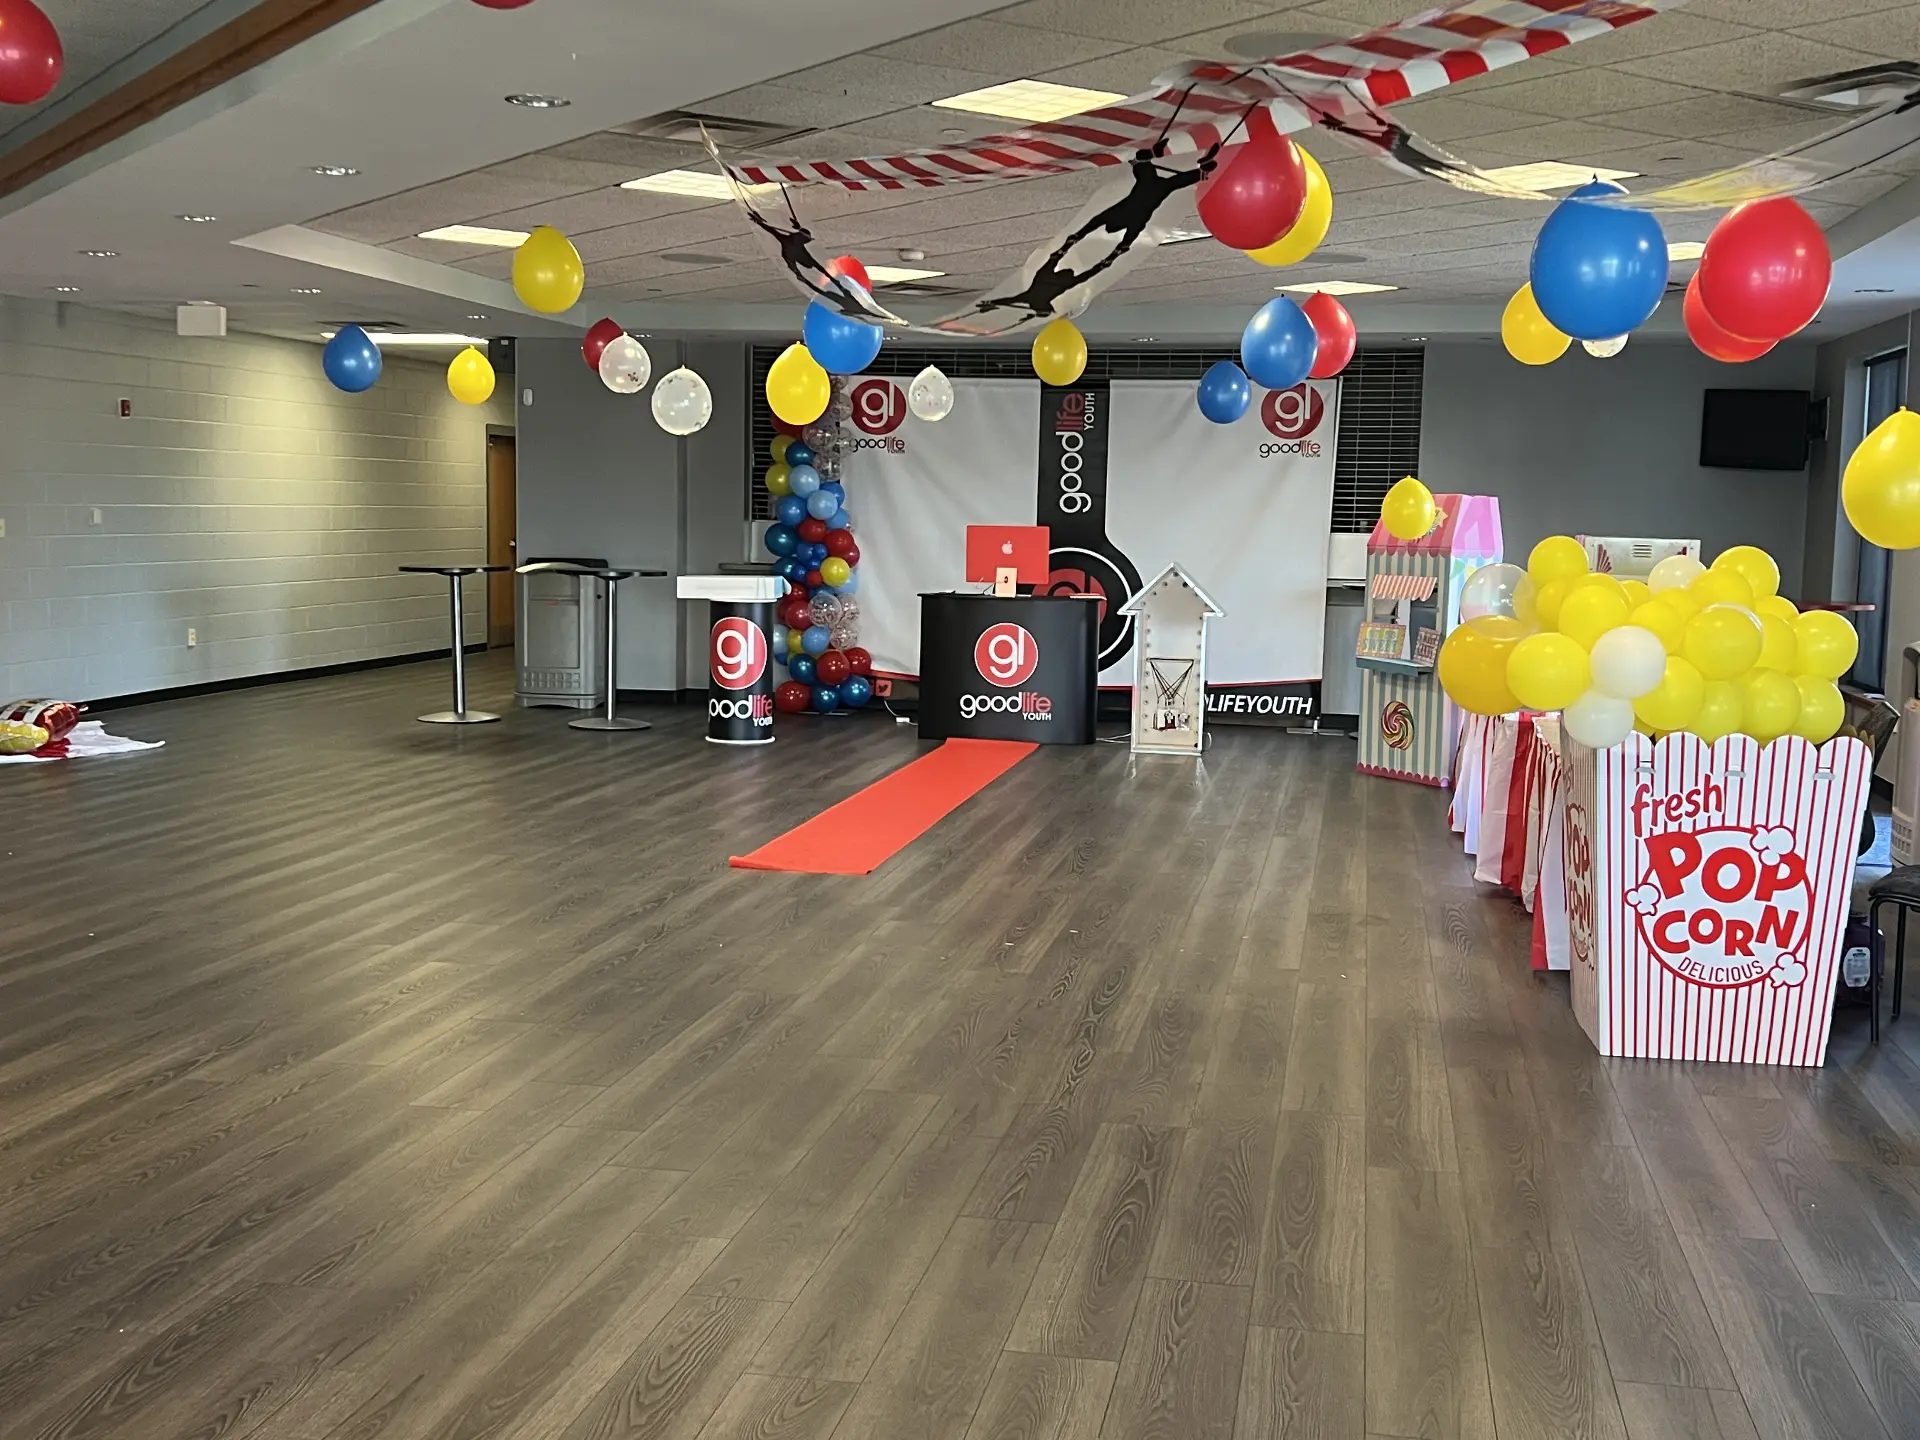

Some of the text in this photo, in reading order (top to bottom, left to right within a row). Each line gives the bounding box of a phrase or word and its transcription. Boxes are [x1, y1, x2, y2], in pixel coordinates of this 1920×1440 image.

[1083, 392, 1095, 431] YOUTH
[1055, 392, 1092, 513] goodlife
[1259, 440, 1321, 458] goodlife
[716, 620, 755, 680] gl
[988, 626, 1025, 678] gl
[709, 694, 773, 719] oodlife
[960, 692, 1052, 719] goodlife
[1022, 712, 1052, 721] YOUTH
[1631, 773, 1723, 838] fresh
[1644, 831, 1806, 904] POP
[1652, 904, 1799, 957] CORN
[1677, 956, 1764, 983] DELICIOUS
